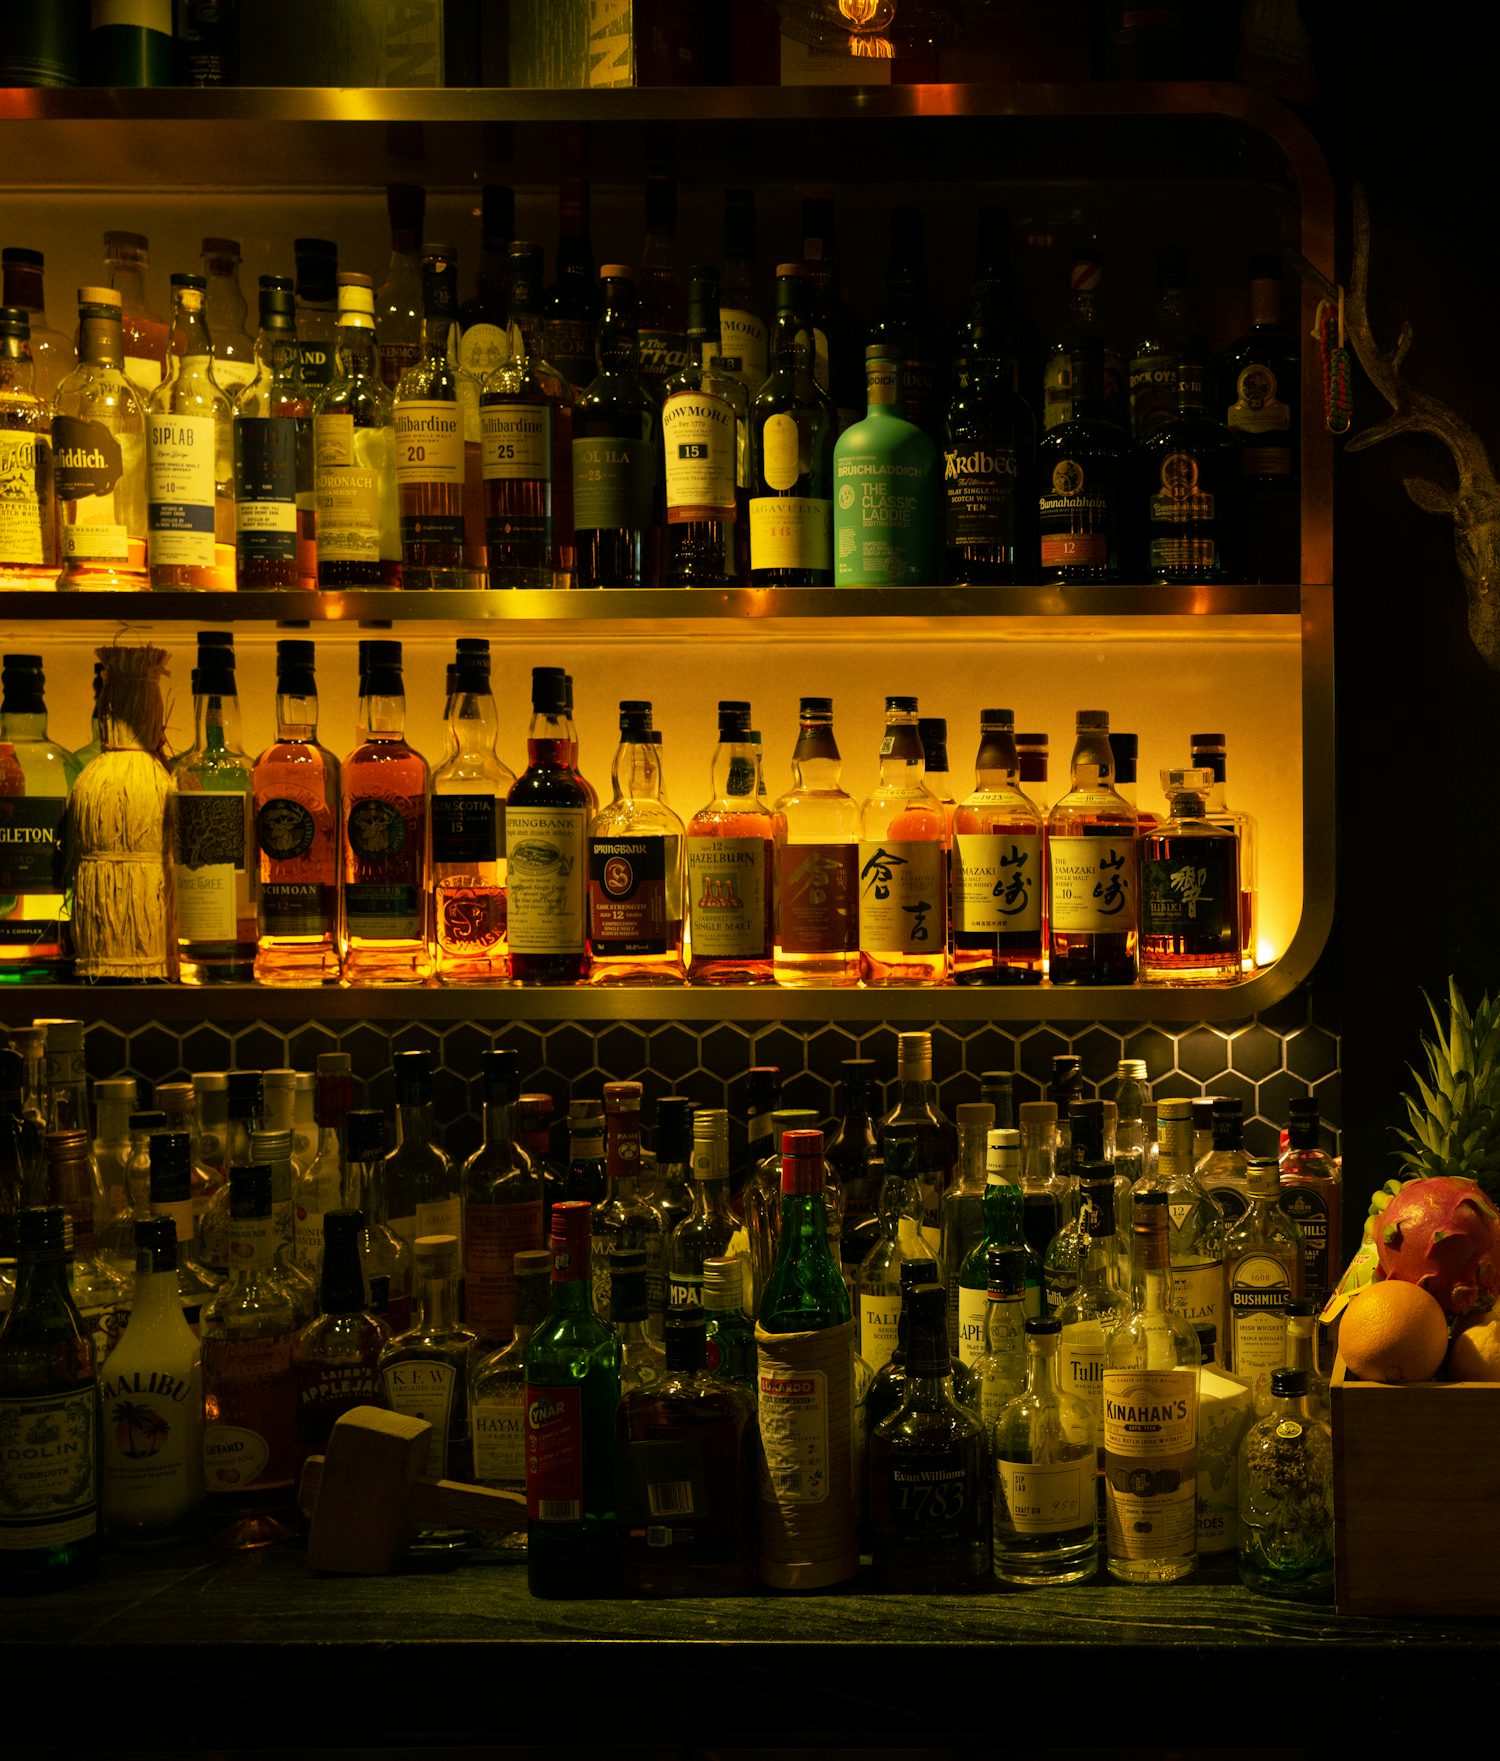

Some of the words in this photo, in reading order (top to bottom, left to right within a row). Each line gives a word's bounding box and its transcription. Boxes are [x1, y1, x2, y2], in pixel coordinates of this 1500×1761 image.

[663, 405, 729, 427] BOWMORE
[153, 428, 195, 447] SIPLAB
[407, 446, 426, 462] 20
[497, 444, 515, 460] 25
[684, 446, 699, 458] 15
[837, 465, 922, 479] BRUICHLADDICH
[165, 481, 176, 494] 10
[861, 482, 888, 496] THE
[963, 487, 990, 495] SINGLE
[861, 496, 917, 510] CLASSIC
[951, 495, 974, 503] SCOTCH
[1039, 497, 1107, 510] Bunnahabhain
[966, 503, 987, 512] TEN
[862, 509, 911, 522] LADDIE
[1063, 542, 1076, 554] 12
[980, 793, 1004, 802] 1923
[452, 801, 491, 812] SCOTIA
[451, 821, 464, 834] 15
[0, 827, 54, 844] GLETON
[593, 843, 648, 855] SPRINGBANK
[712, 841, 723, 852] 12
[689, 851, 755, 868] HAZELBURN
[1054, 858, 1067, 866] THE
[1054, 866, 1096, 875] YAMAZAKI
[992, 844, 1032, 916] 山崎
[1054, 881, 1074, 889] WHISKY
[1092, 848, 1129, 916] 山崎
[1061, 888, 1073, 901] 10
[609, 903, 647, 911] STRENGTH
[1149, 903, 1183, 913] HIBIKI
[612, 910, 625, 920] 12
[694, 920, 725, 931] SINGLE
[726, 919, 753, 930] MALT
[1172, 1206, 1186, 1217] 12
[1233, 1291, 1290, 1306] BUSHMILLS
[866, 1311, 898, 1325] TALI
[1256, 1324, 1284, 1332] WHISKEY
[320, 1368, 372, 1382] LAIRD'S
[103, 1371, 193, 1403] MALIBU
[392, 1384, 429, 1393] ORGANIC
[430, 1384, 448, 1392] GIN
[761, 1380, 813, 1394] LUXARDO
[528, 1400, 565, 1430] CYNAR
[1106, 1398, 1187, 1423] KINAHAN'S
[7, 1441, 78, 1460] DOLIN
[892, 1469, 920, 1483] Evan
[920, 1468, 966, 1480] Williams
[1014, 1475, 1026, 1485] SIP
[895, 1482, 967, 1520] 1783
[1014, 1505, 1031, 1515] CRAFT
[1030, 1505, 1042, 1514] GIN
[1196, 1516, 1225, 1529] RDES
